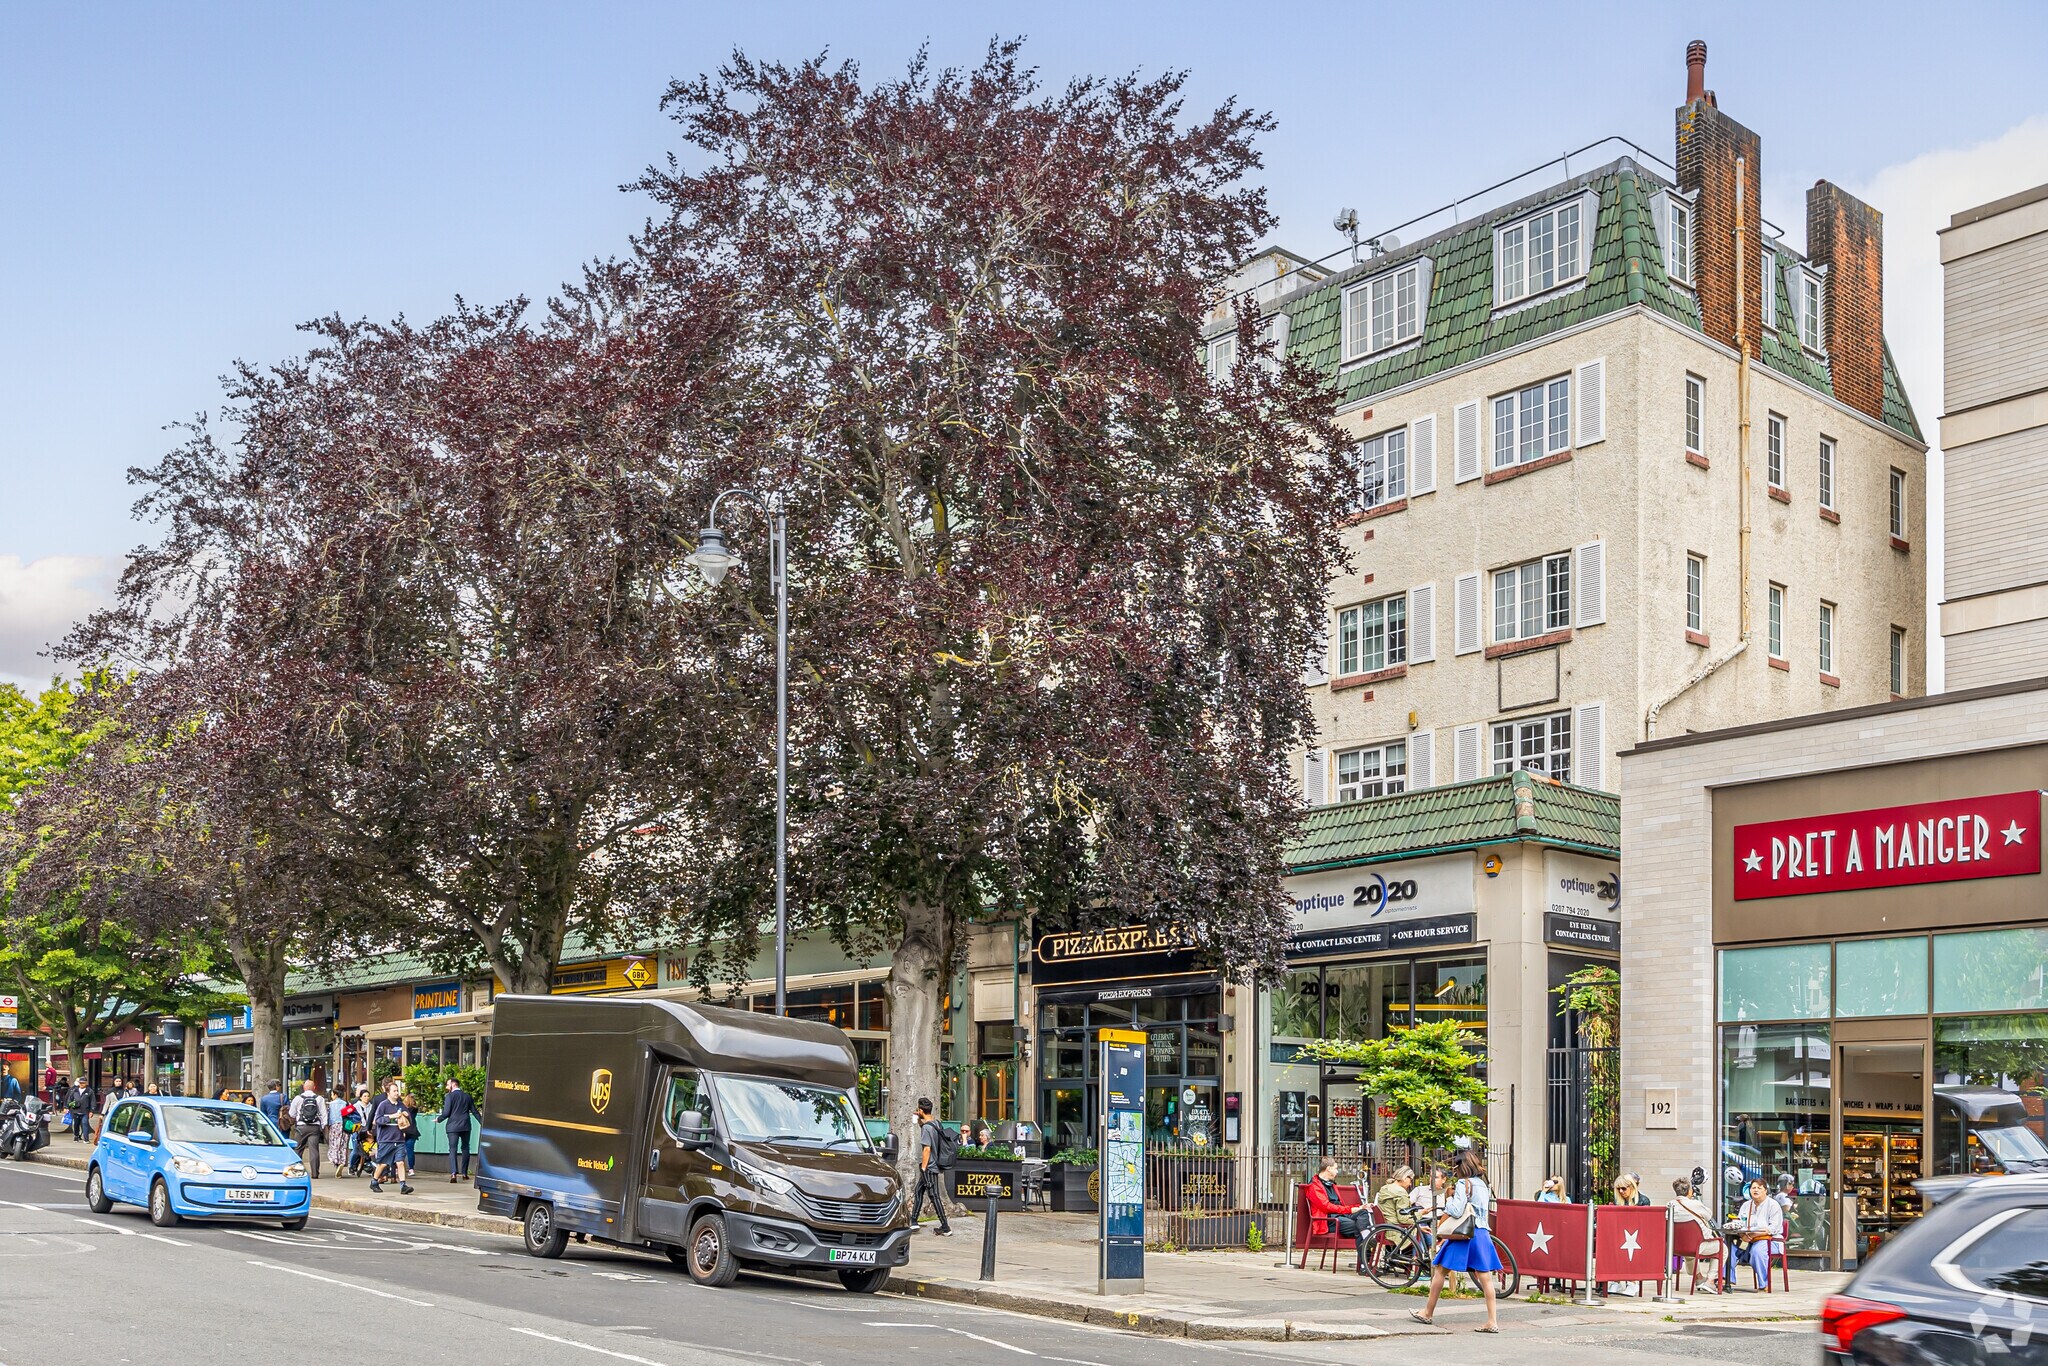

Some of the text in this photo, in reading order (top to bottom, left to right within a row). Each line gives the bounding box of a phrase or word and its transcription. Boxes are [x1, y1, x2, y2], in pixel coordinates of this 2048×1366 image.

[1772, 814, 1991, 880] PRET A MANGER
[1560, 877, 1595, 895] optique
[1295, 893, 1345, 914] optique
[1551, 903, 1590, 917] 0207 794 2020
[1397, 931, 1413, 940] ONE
[1414, 928, 1436, 938] HOUR
[1436, 924, 1469, 936] SERVICE
[1569, 921, 1580, 929] EYE
[1579, 922, 1592, 931] TEST
[1301, 938, 1335, 949] CONTACT
[1334, 936, 1354, 946] LENS
[1354, 933, 1382, 943] CENTRE
[1555, 929, 1611, 943] CONTACT LENS CENTRE
[632, 971, 645, 979] GBK
[415, 989, 459, 1010] PRINTLINE
[514, 1082, 530, 1092] Services
[592, 1083, 609, 1106] ups
[1335, 1106, 1357, 1117] SALE
[1651, 1102, 1670, 1114] 192
[1785, 1097, 1816, 1107] BAGUETTES
[1875, 1102, 1894, 1110] WRAPS
[1904, 1104, 1922, 1112] SALADS
[577, 1158, 608, 1172] Electric Vehicle
[967, 1174, 1002, 1185] PIZZA
[228, 1190, 270, 1200] LT65 NRV
[835, 1251, 874, 1262] BP74 KLK
